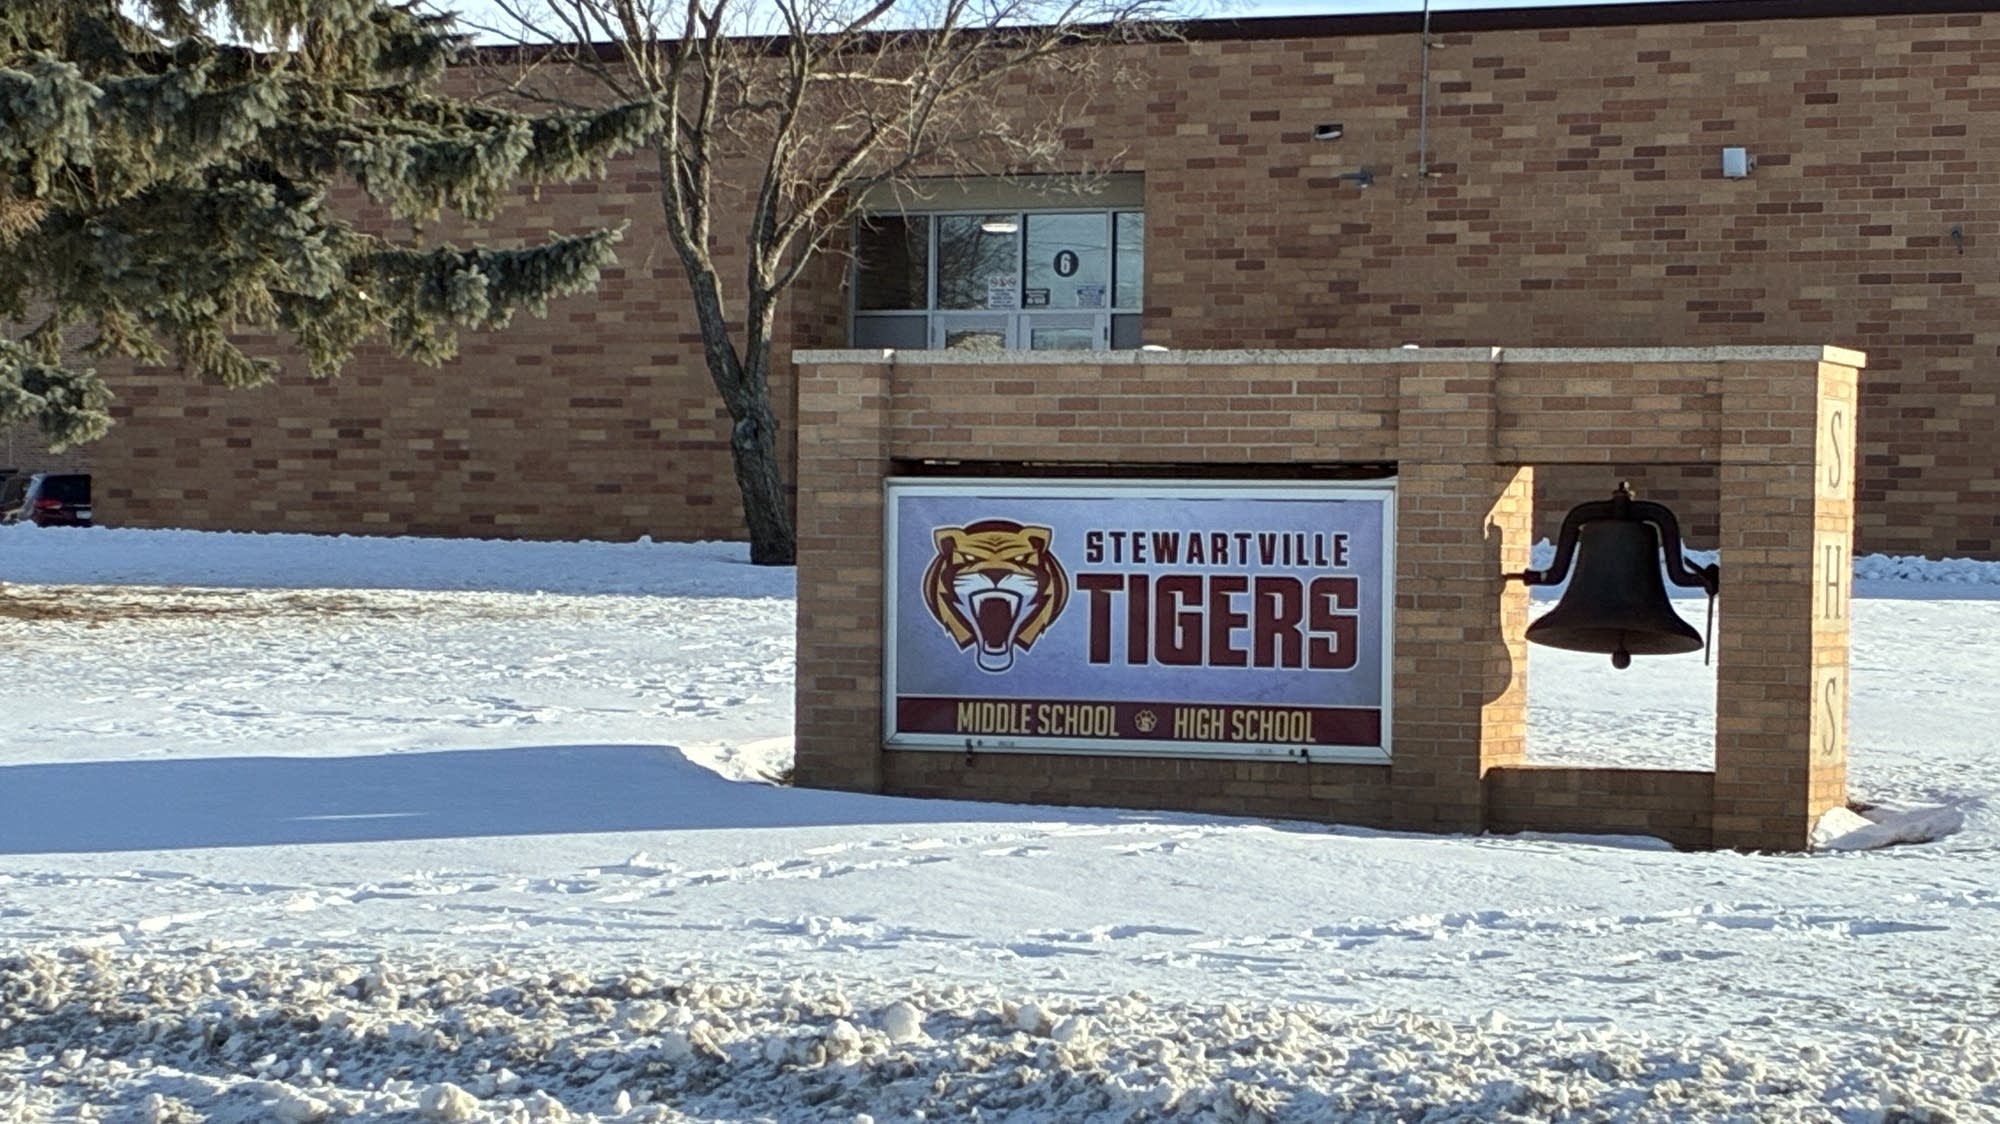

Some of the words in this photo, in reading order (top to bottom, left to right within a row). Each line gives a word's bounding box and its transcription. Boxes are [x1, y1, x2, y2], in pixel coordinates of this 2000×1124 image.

[1060, 253, 1073, 274] 6
[1086, 531, 1349, 566] STEWARTVILLE
[1076, 574, 1359, 669] TIGERS
[956, 702, 1032, 735] MIDDLE
[1037, 705, 1119, 738] SCHOOL
[1174, 707, 1226, 739] HIGH
[1231, 710, 1316, 743] SCHOOL
